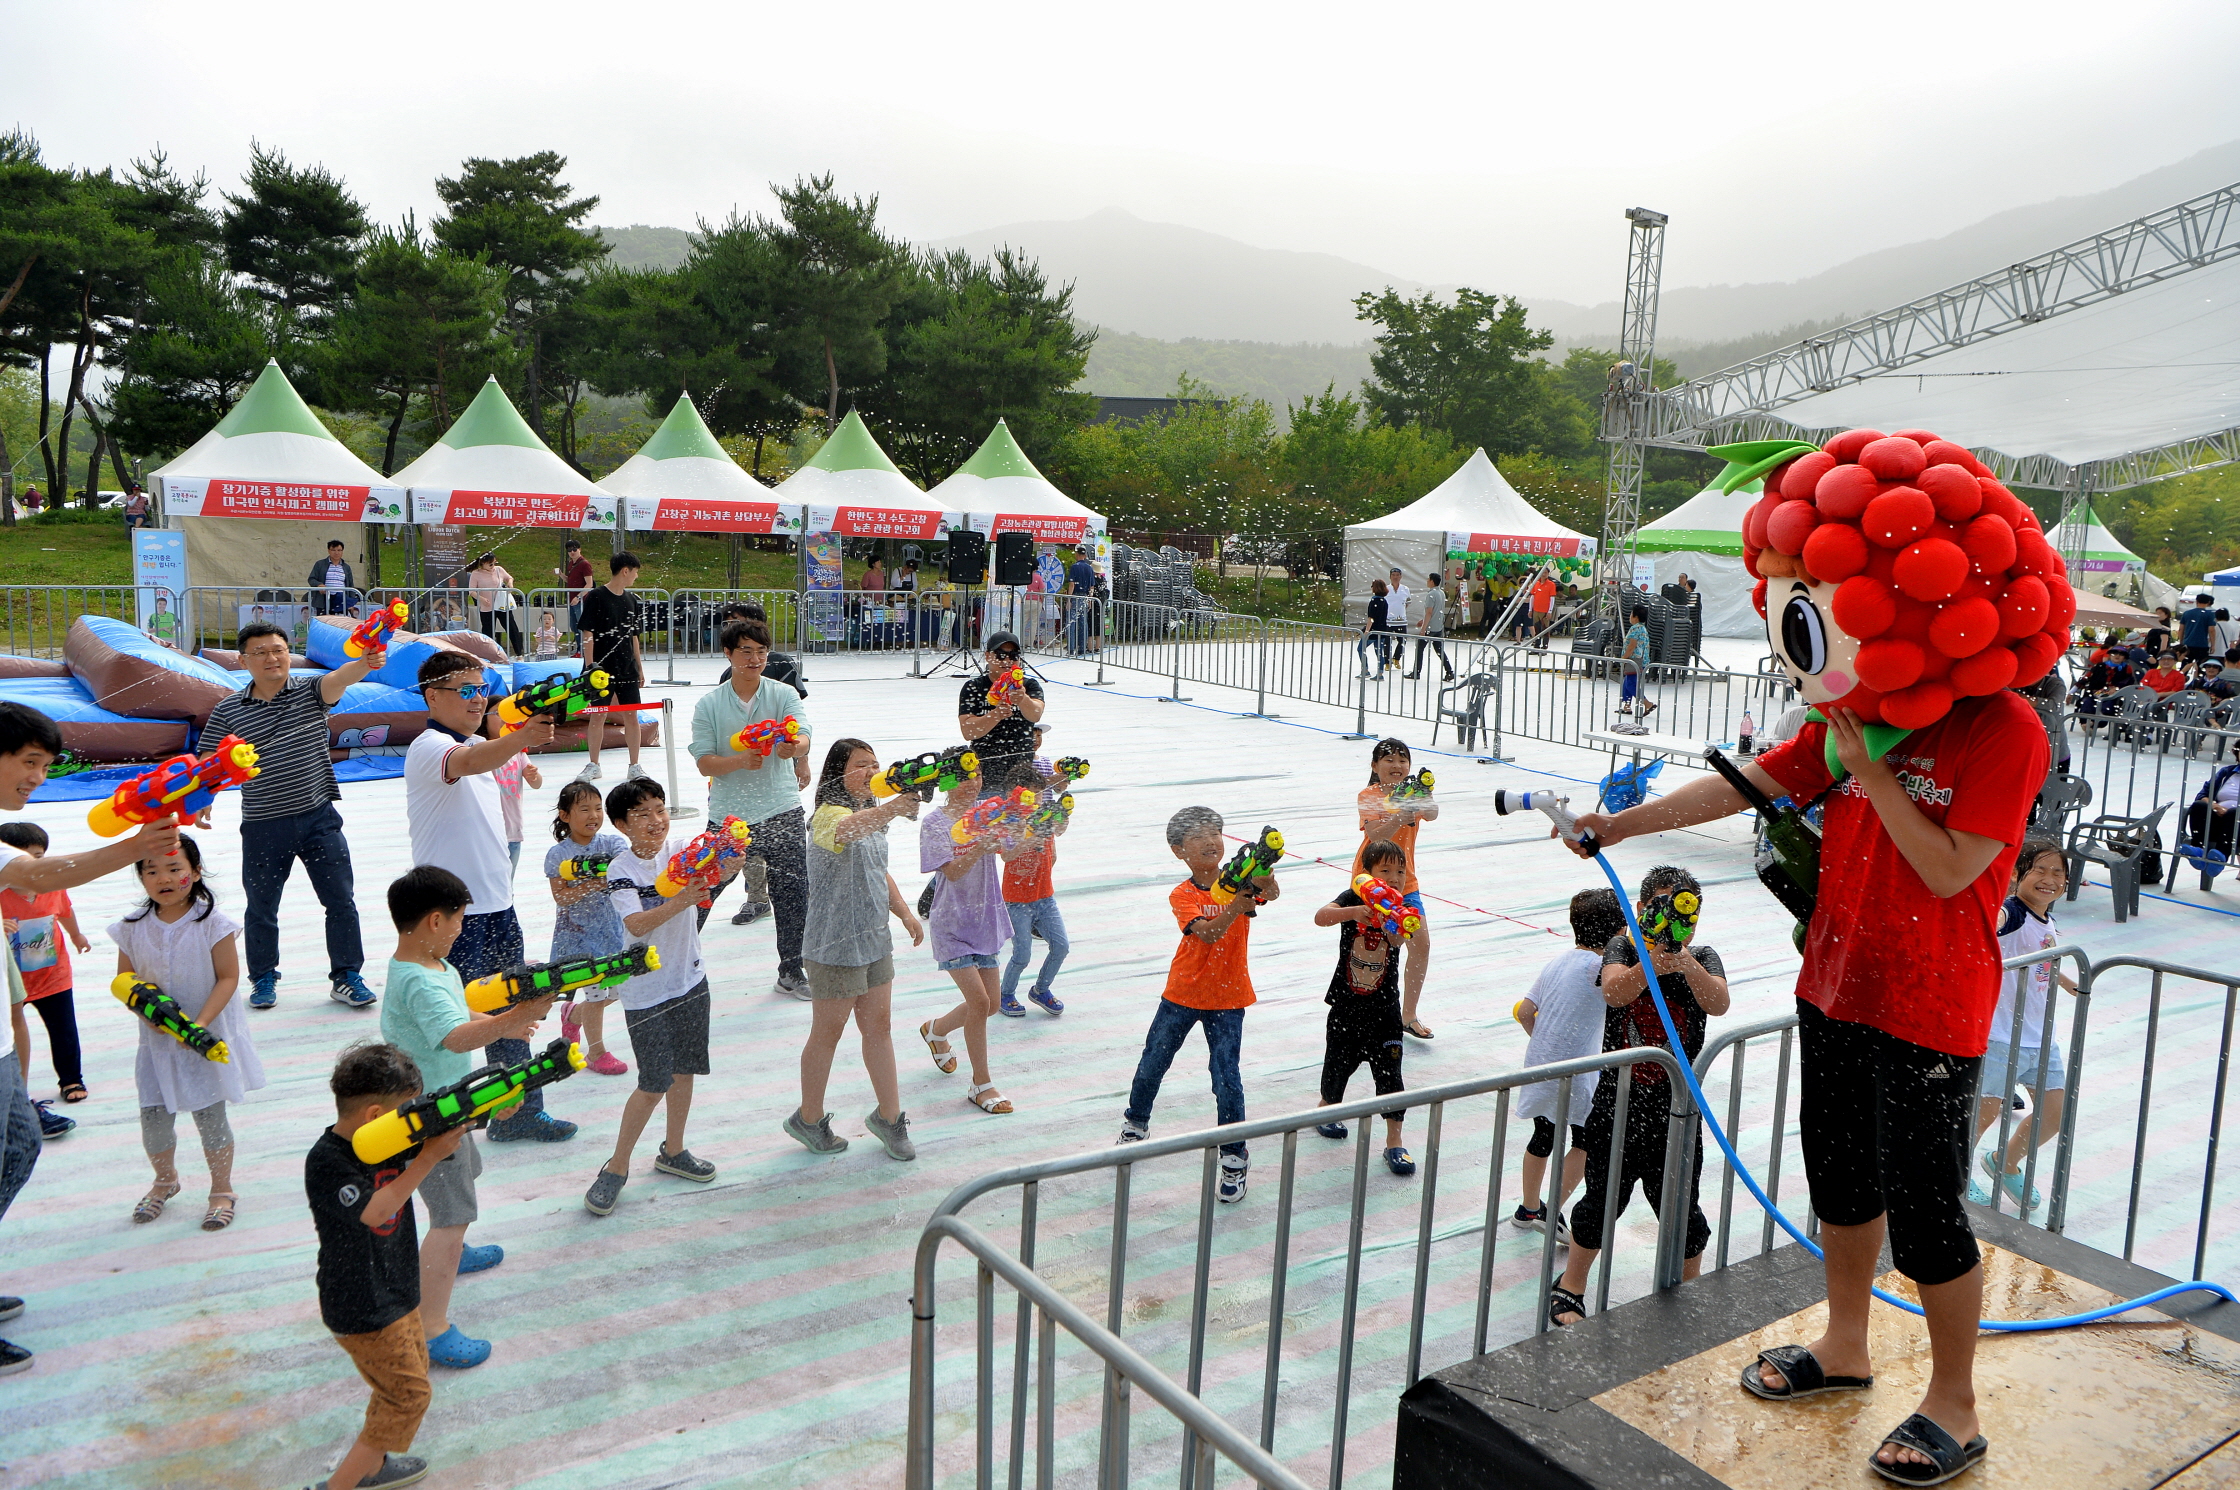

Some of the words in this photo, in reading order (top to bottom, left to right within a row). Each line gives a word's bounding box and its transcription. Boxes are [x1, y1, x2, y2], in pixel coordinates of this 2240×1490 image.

[222, 484, 272, 496] 장기기증
[274, 485, 323, 498] 활성화를
[326, 487, 350, 499] 위한
[223, 497, 260, 508] 대국민
[264, 498, 312, 510] 인식제고
[315, 500, 350, 512] 캠페인
[483, 497, 528, 508] 복분자로
[531, 498, 552, 509] 만든
[454, 508, 487, 518] 최고의
[492, 508, 512, 520] 커피
[660, 509, 688, 520] 고창군
[692, 510, 731, 520] 귀농귀촌
[734, 512, 772, 522] 상담부스
[847, 511, 874, 522] 한반도
[878, 512, 886, 522] 첫
[889, 513, 906, 523] 수도
[910, 514, 928, 524] 고창
[874, 524, 891, 534] 관광
